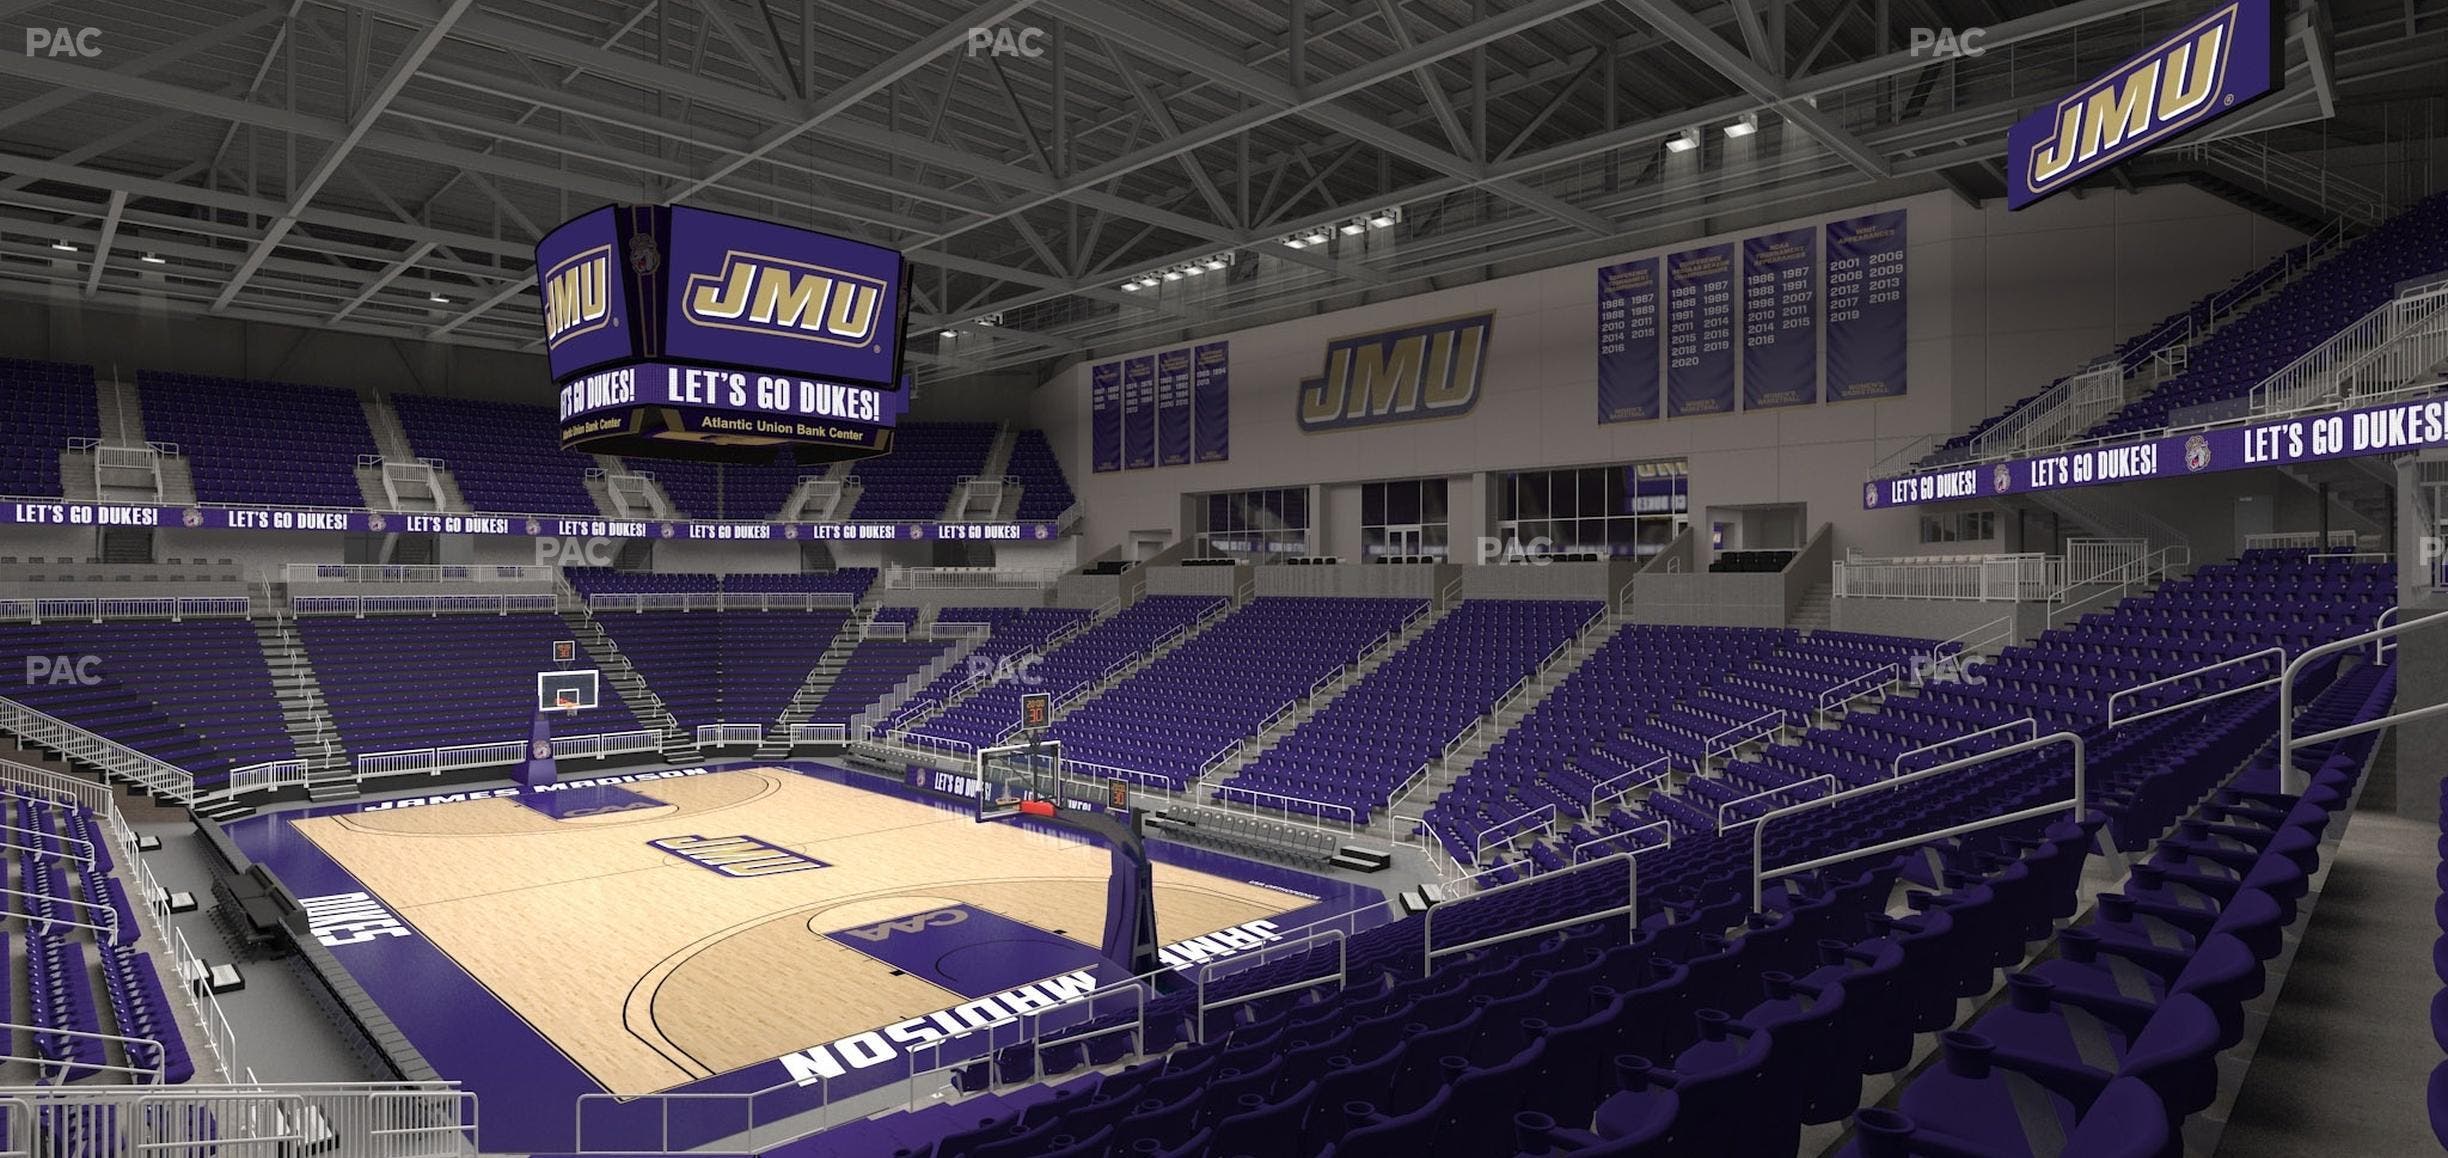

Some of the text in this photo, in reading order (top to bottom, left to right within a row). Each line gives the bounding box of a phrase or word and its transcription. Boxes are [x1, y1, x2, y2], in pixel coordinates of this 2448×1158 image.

[2034, 24, 2223, 182] JMU
[1830, 250, 1904, 271] 2001 2006
[1748, 266, 1809, 286] 1986 1987
[1830, 263, 1904, 284] 2008 2009
[1782, 291, 1813, 305] 2007
[1830, 277, 1900, 297] 2012 2013
[547, 257, 608, 343] JMU
[694, 263, 877, 339] JMU
[1830, 297, 1859, 310] 2017
[1302, 325, 1484, 424] JMU
[574, 380, 585, 414] GO
[587, 369, 635, 410] DUKES!
[668, 367, 880, 422] LET'S GO DUKES!
[702, 416, 864, 441] Atlantic Union Bank Center
[2244, 401, 2448, 463] LET'S GO DUKES!
[2031, 443, 2157, 488] LET'S GO DUKES!
[1892, 469, 1977, 504] LET'S GO DUKES!
[16, 504, 158, 526] LET'S GO DUKES!
[228, 510, 348, 530] LET'S GO DUKES!
[407, 514, 509, 534] LET'S GO DUKES!
[559, 520, 646, 538] LET'S GO DUKES!
[689, 525, 770, 539] LET'S GO DUKES!
[813, 525, 895, 539] LET'S GO DUKES!
[938, 525, 1020, 539] LET'S GO DUKES!
[1029, 708, 1043, 723] 30
[364, 768, 709, 812] JAMES MADISON
[934, 772, 954, 793] LET'S
[655, 836, 821, 877] JMU
[298, 892, 412, 947] DUKES
[845, 909, 968, 942] CAA
[1158, 919, 1284, 971] JAM
[779, 970, 1098, 1087] MADISON
